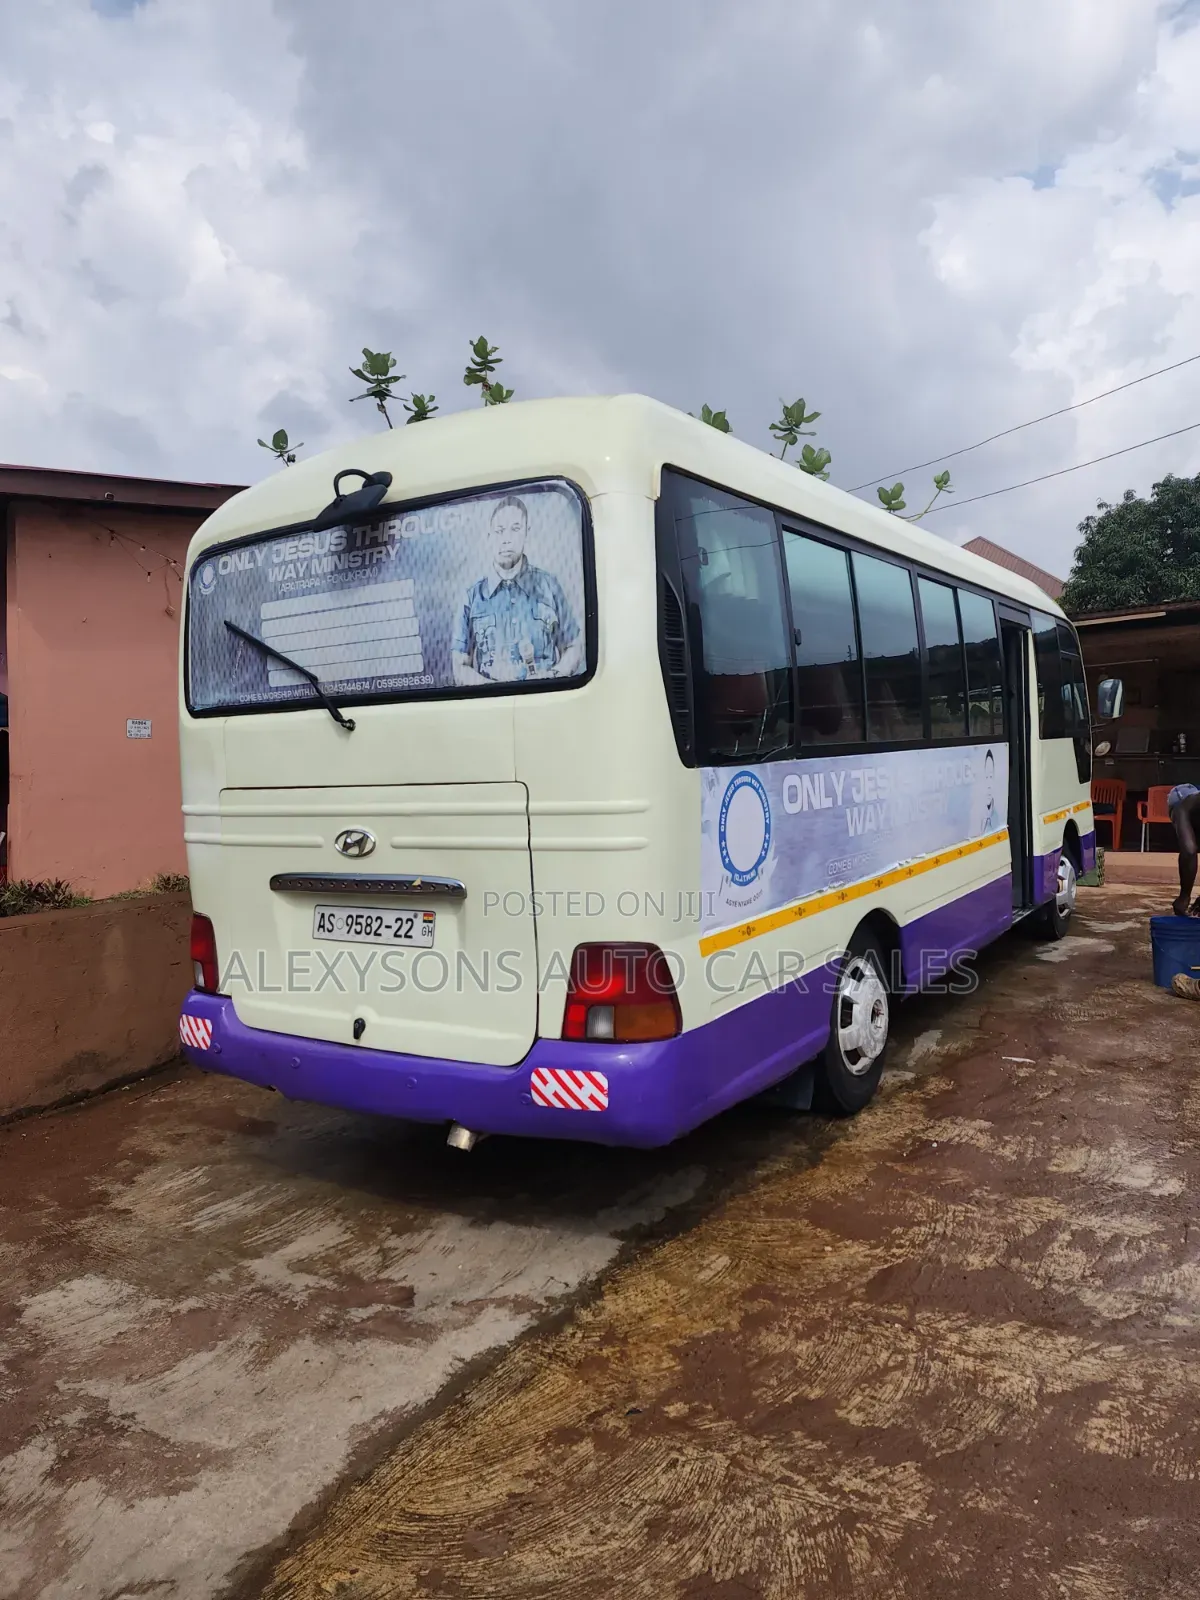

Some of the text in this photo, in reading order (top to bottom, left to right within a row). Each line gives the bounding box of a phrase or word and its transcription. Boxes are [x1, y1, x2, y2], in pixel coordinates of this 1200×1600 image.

[218, 545, 268, 576] ONLY
[271, 529, 348, 564] JESUS
[268, 542, 400, 583] WAY MINISTRY
[240, 693, 258, 702] COME
[262, 690, 293, 701] WORSHIP
[293, 688, 310, 698] WITH
[782, 770, 846, 815] ONLY
[846, 801, 888, 838] WAY
[828, 858, 847, 875] COME
[316, 912, 433, 940] AS 9582-22 GH
